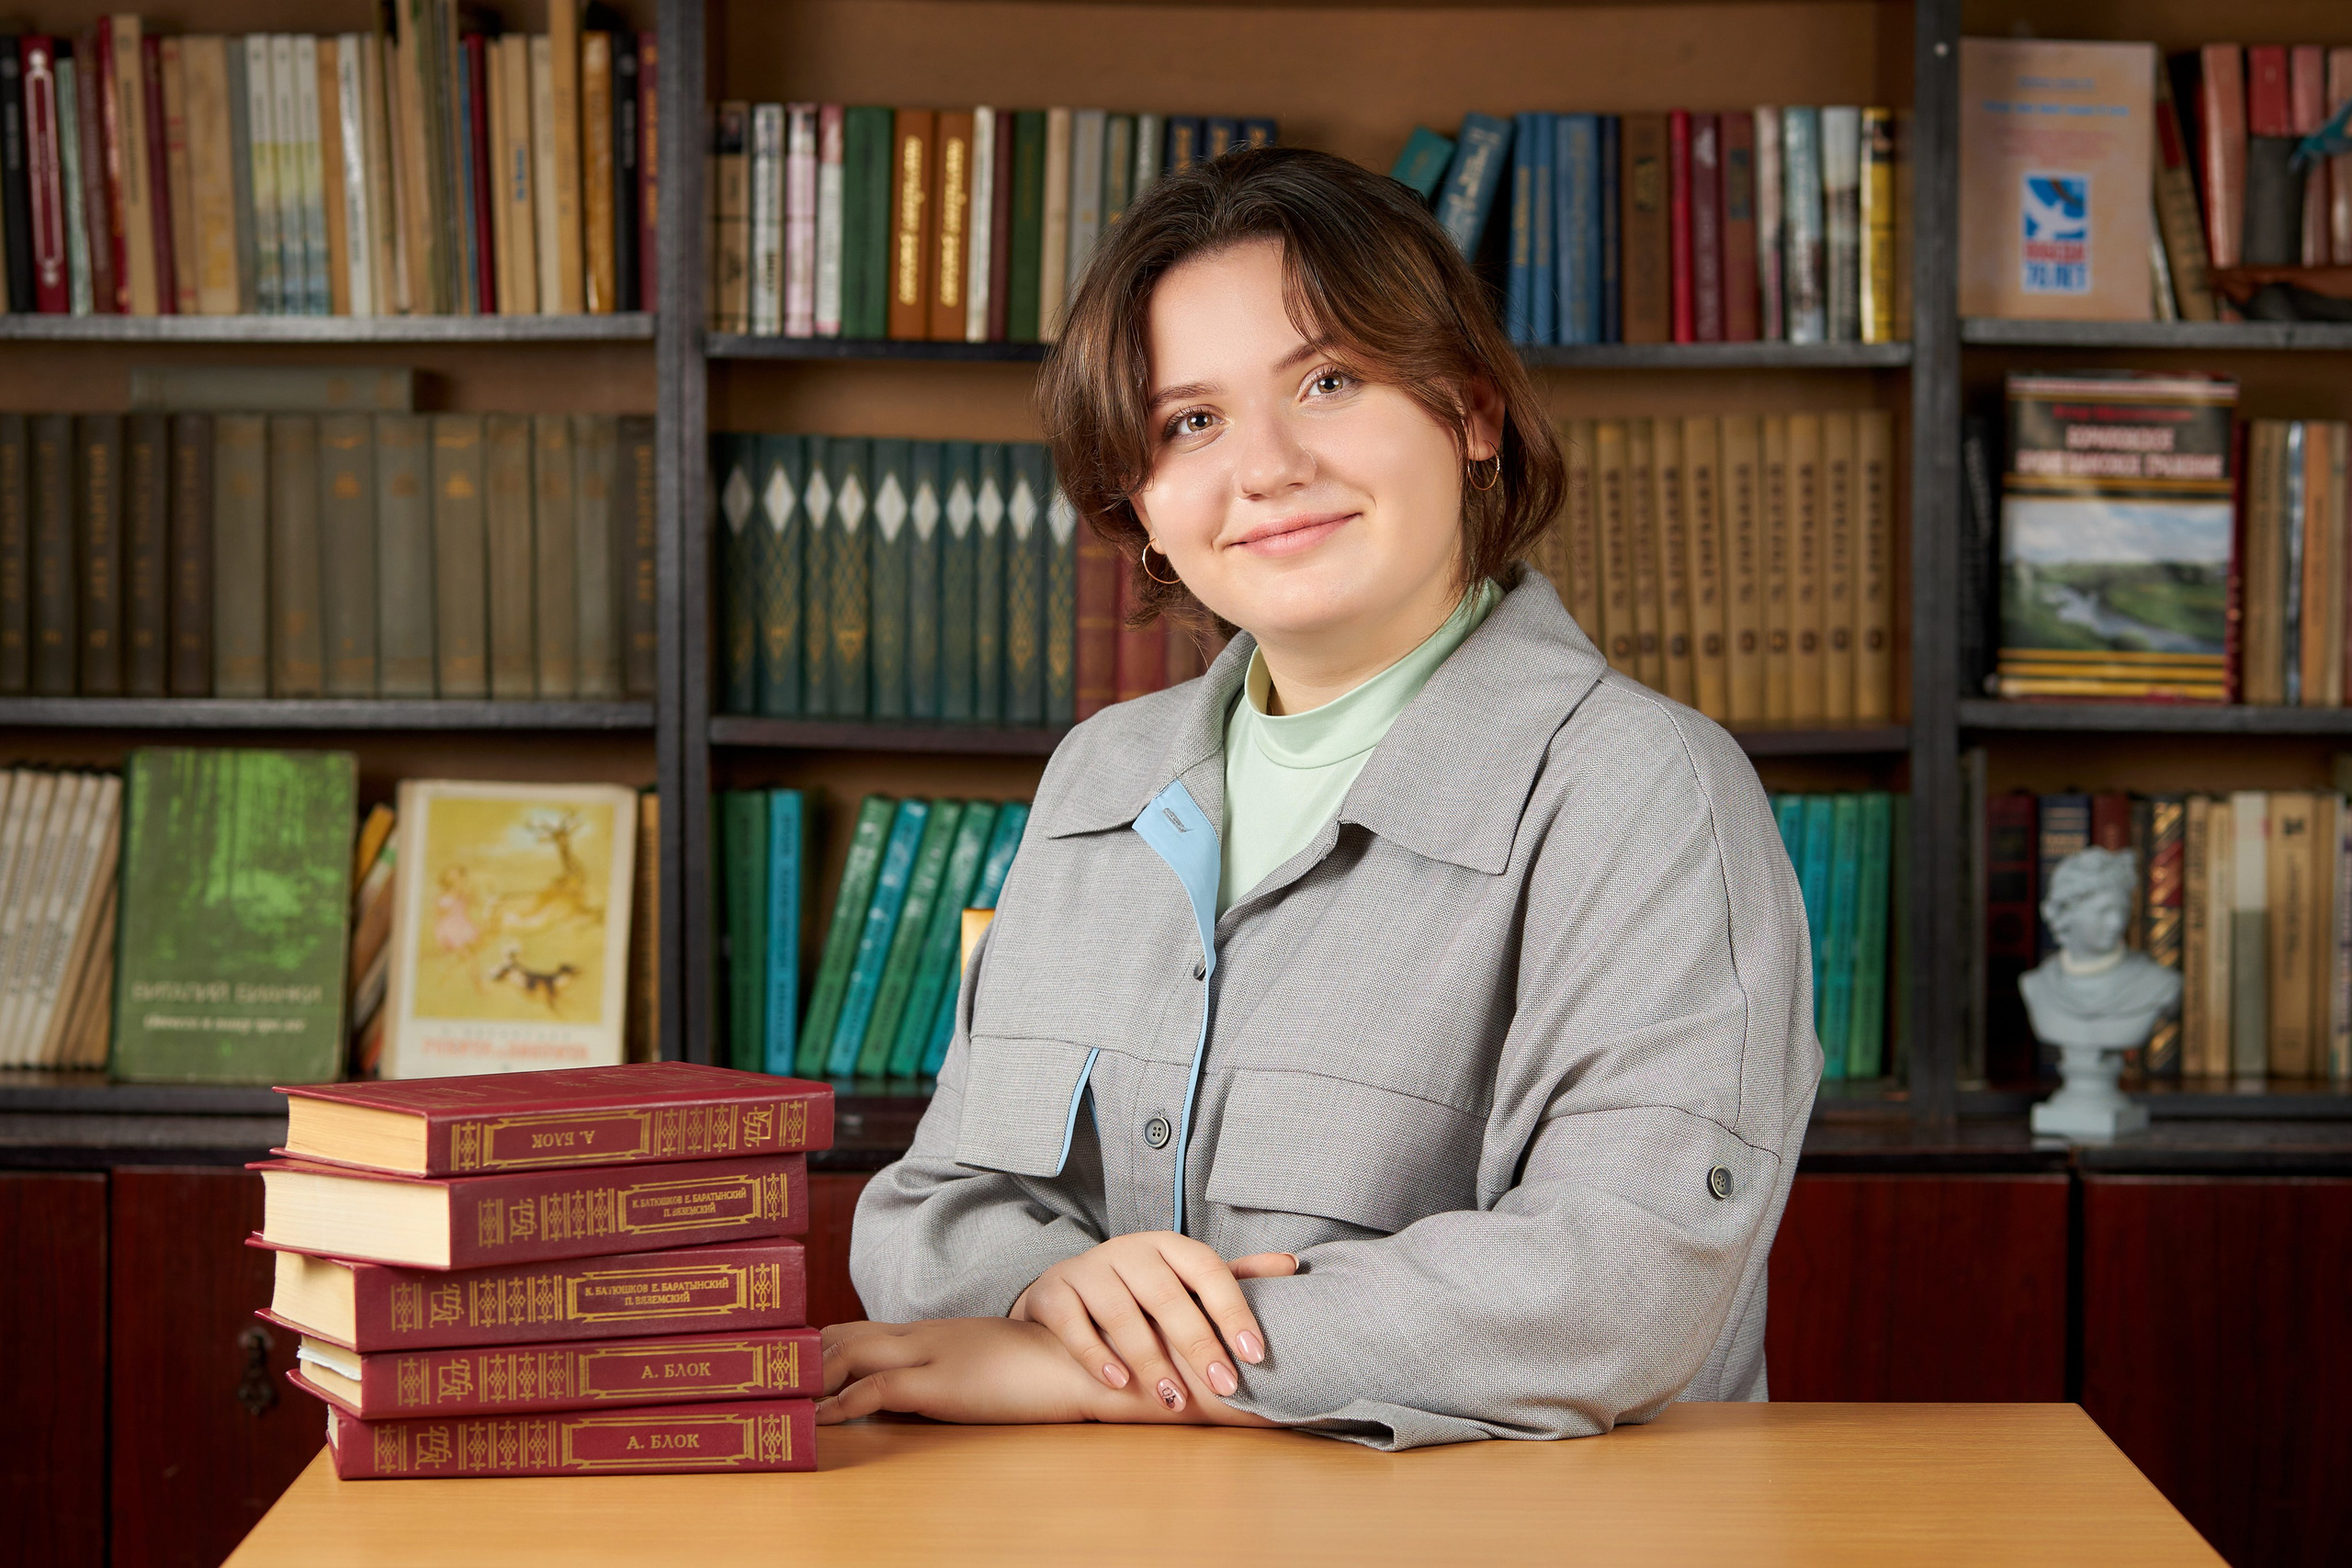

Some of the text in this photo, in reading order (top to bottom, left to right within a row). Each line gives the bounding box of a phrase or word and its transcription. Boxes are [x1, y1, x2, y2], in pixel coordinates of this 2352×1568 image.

[532, 1130, 595, 1148] А. БЛОК
[692, 1187, 747, 1203] БАРАТЫНСКИЙ
[584, 1277, 729, 1296] К. БАТЮШКОВ Е. БАРАТЫНСКИЙ
[635, 1291, 690, 1305] ВЯЗЕМСКИЙ
[640, 1362, 711, 1379] А. БЛОК
[627, 1434, 700, 1450] А. БЛОК
